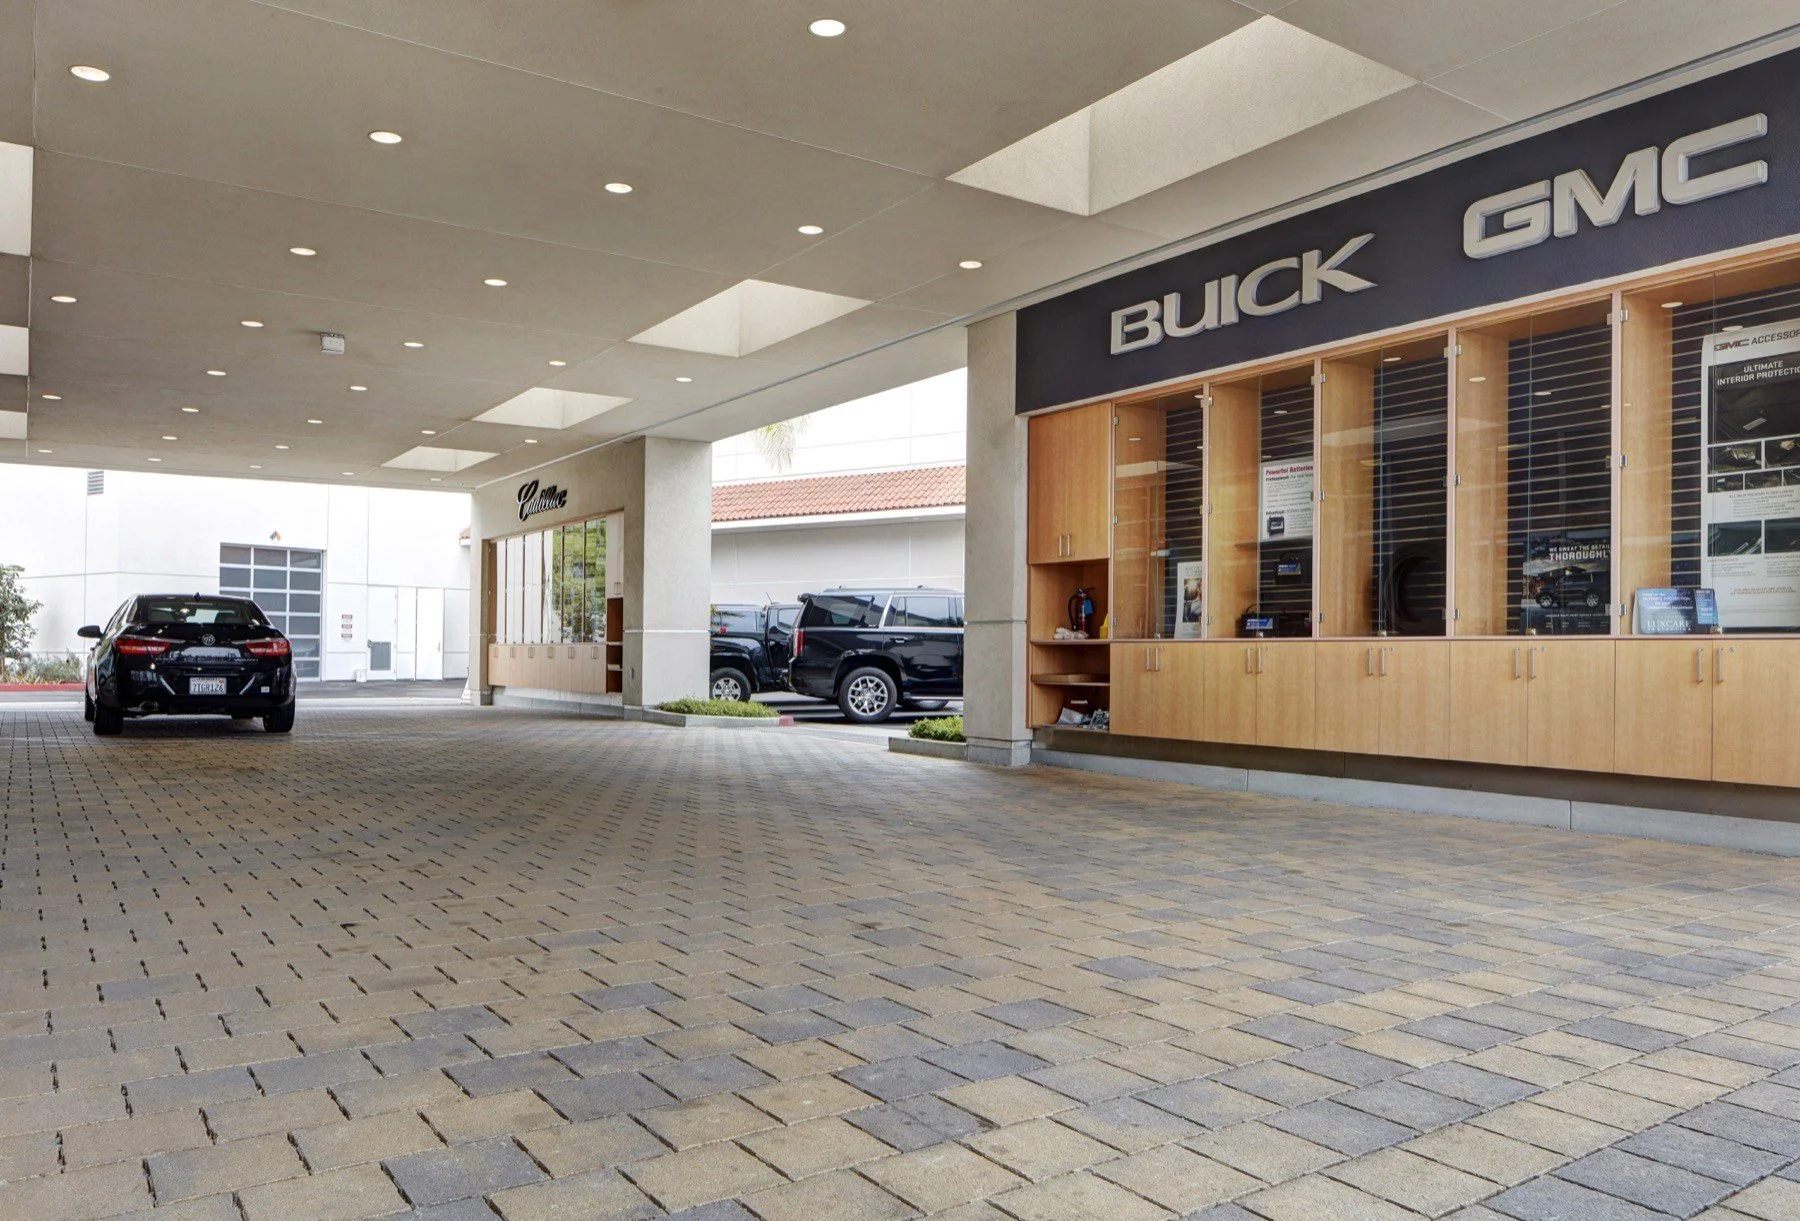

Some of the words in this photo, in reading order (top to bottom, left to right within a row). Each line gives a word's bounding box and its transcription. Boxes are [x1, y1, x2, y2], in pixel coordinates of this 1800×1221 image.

[1110, 232, 1378, 356] BUICK
[1463, 112, 1768, 260] GMC
[1714, 338, 1750, 352] GMC
[1743, 360, 1784, 374] ULTIMATE
[1717, 373, 1755, 386] INTERIOR
[516, 479, 568, 522] Cadillac
